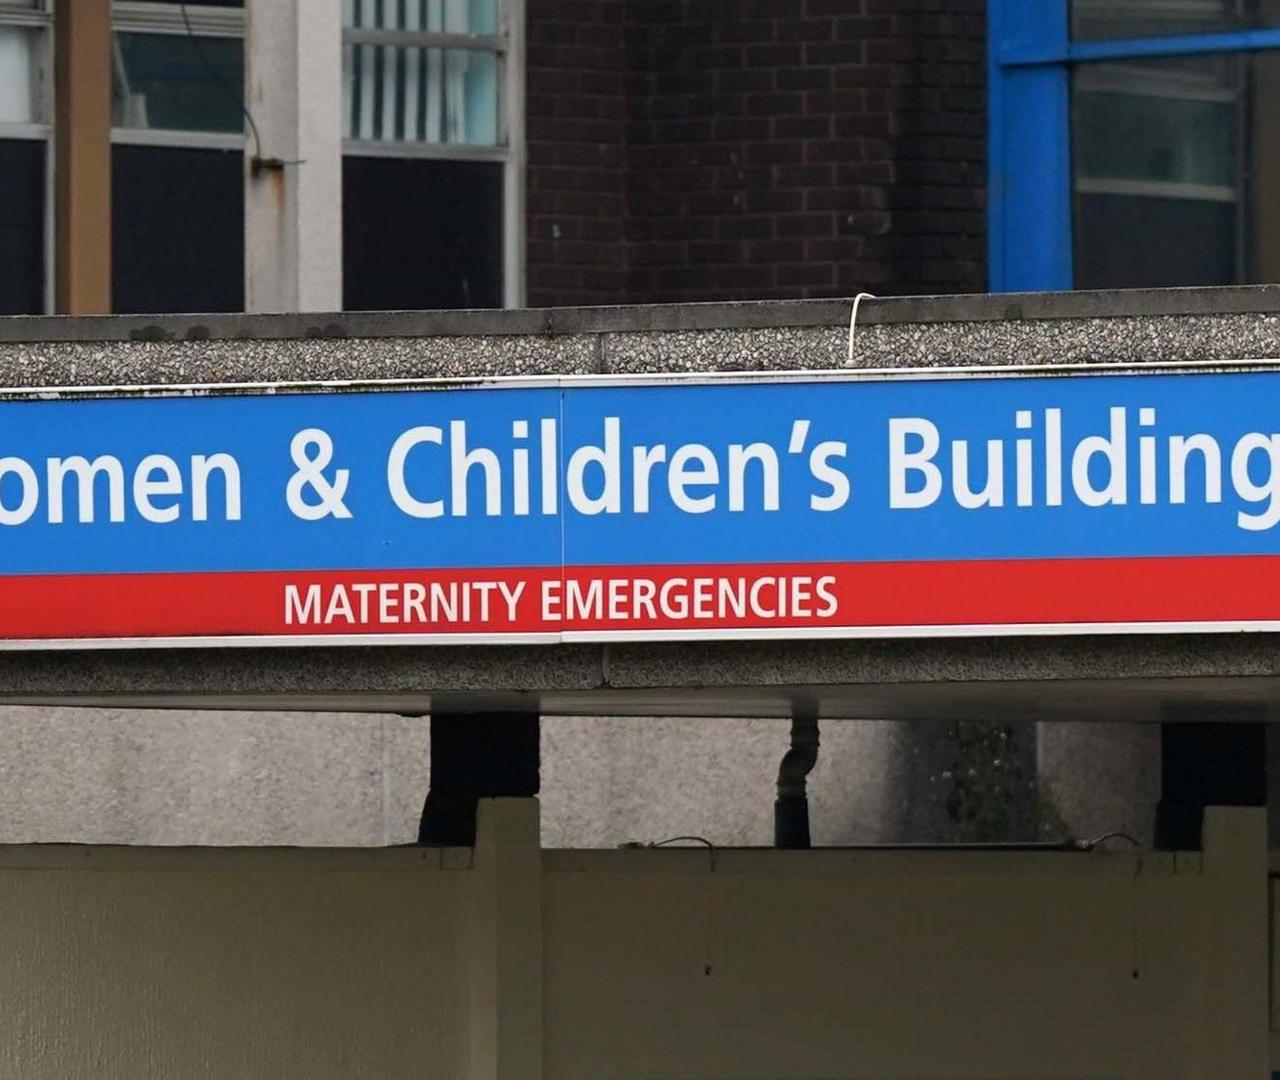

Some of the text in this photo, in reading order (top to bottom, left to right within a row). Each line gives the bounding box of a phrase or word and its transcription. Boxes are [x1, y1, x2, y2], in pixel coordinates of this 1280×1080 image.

[285, 427, 353, 519] &
[386, 417, 851, 518] Children’s
[284, 575, 839, 625] MATERNITY EMERGENCIES
